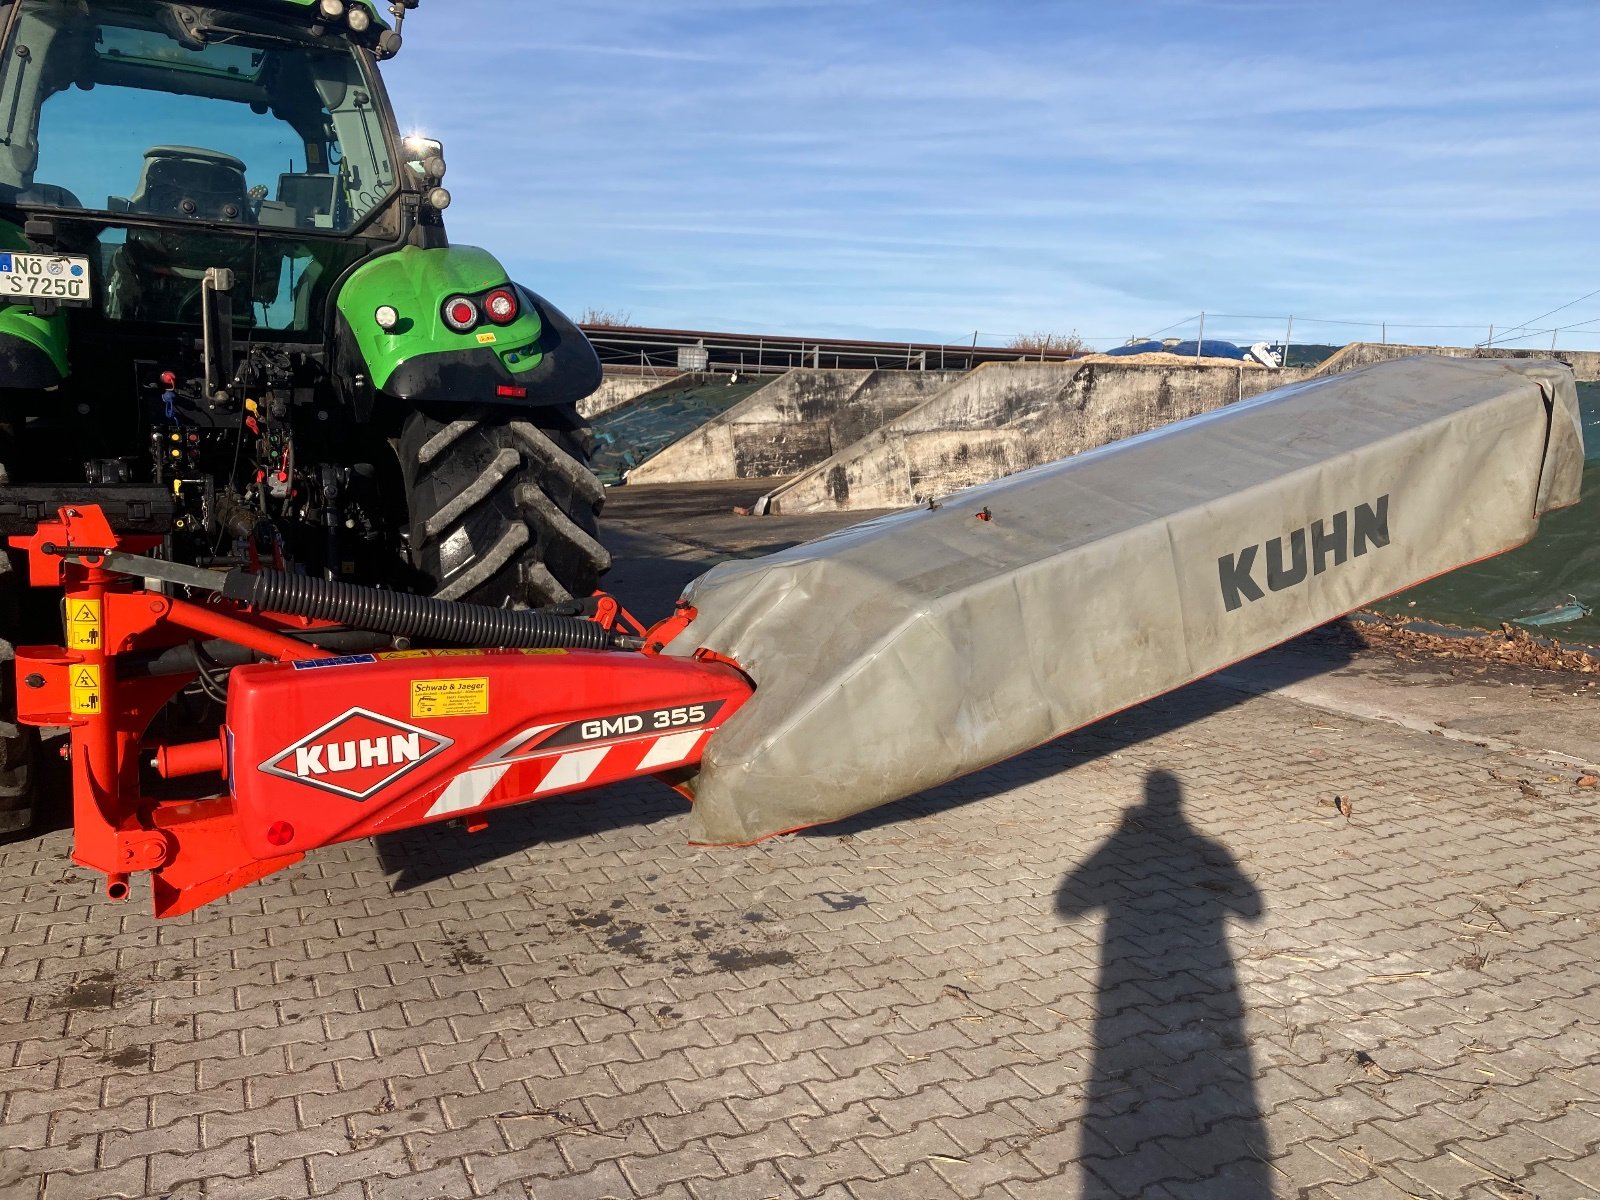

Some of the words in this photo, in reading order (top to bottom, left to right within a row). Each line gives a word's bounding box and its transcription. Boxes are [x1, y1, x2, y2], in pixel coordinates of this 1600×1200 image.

[14, 256, 42, 275] NÖ
[1217, 493, 1390, 612] KUHN
[414, 683, 448, 693] Schwab
[581, 715, 643, 740] GMD
[653, 705, 706, 729] 355
[295, 732, 420, 777] KUHN
